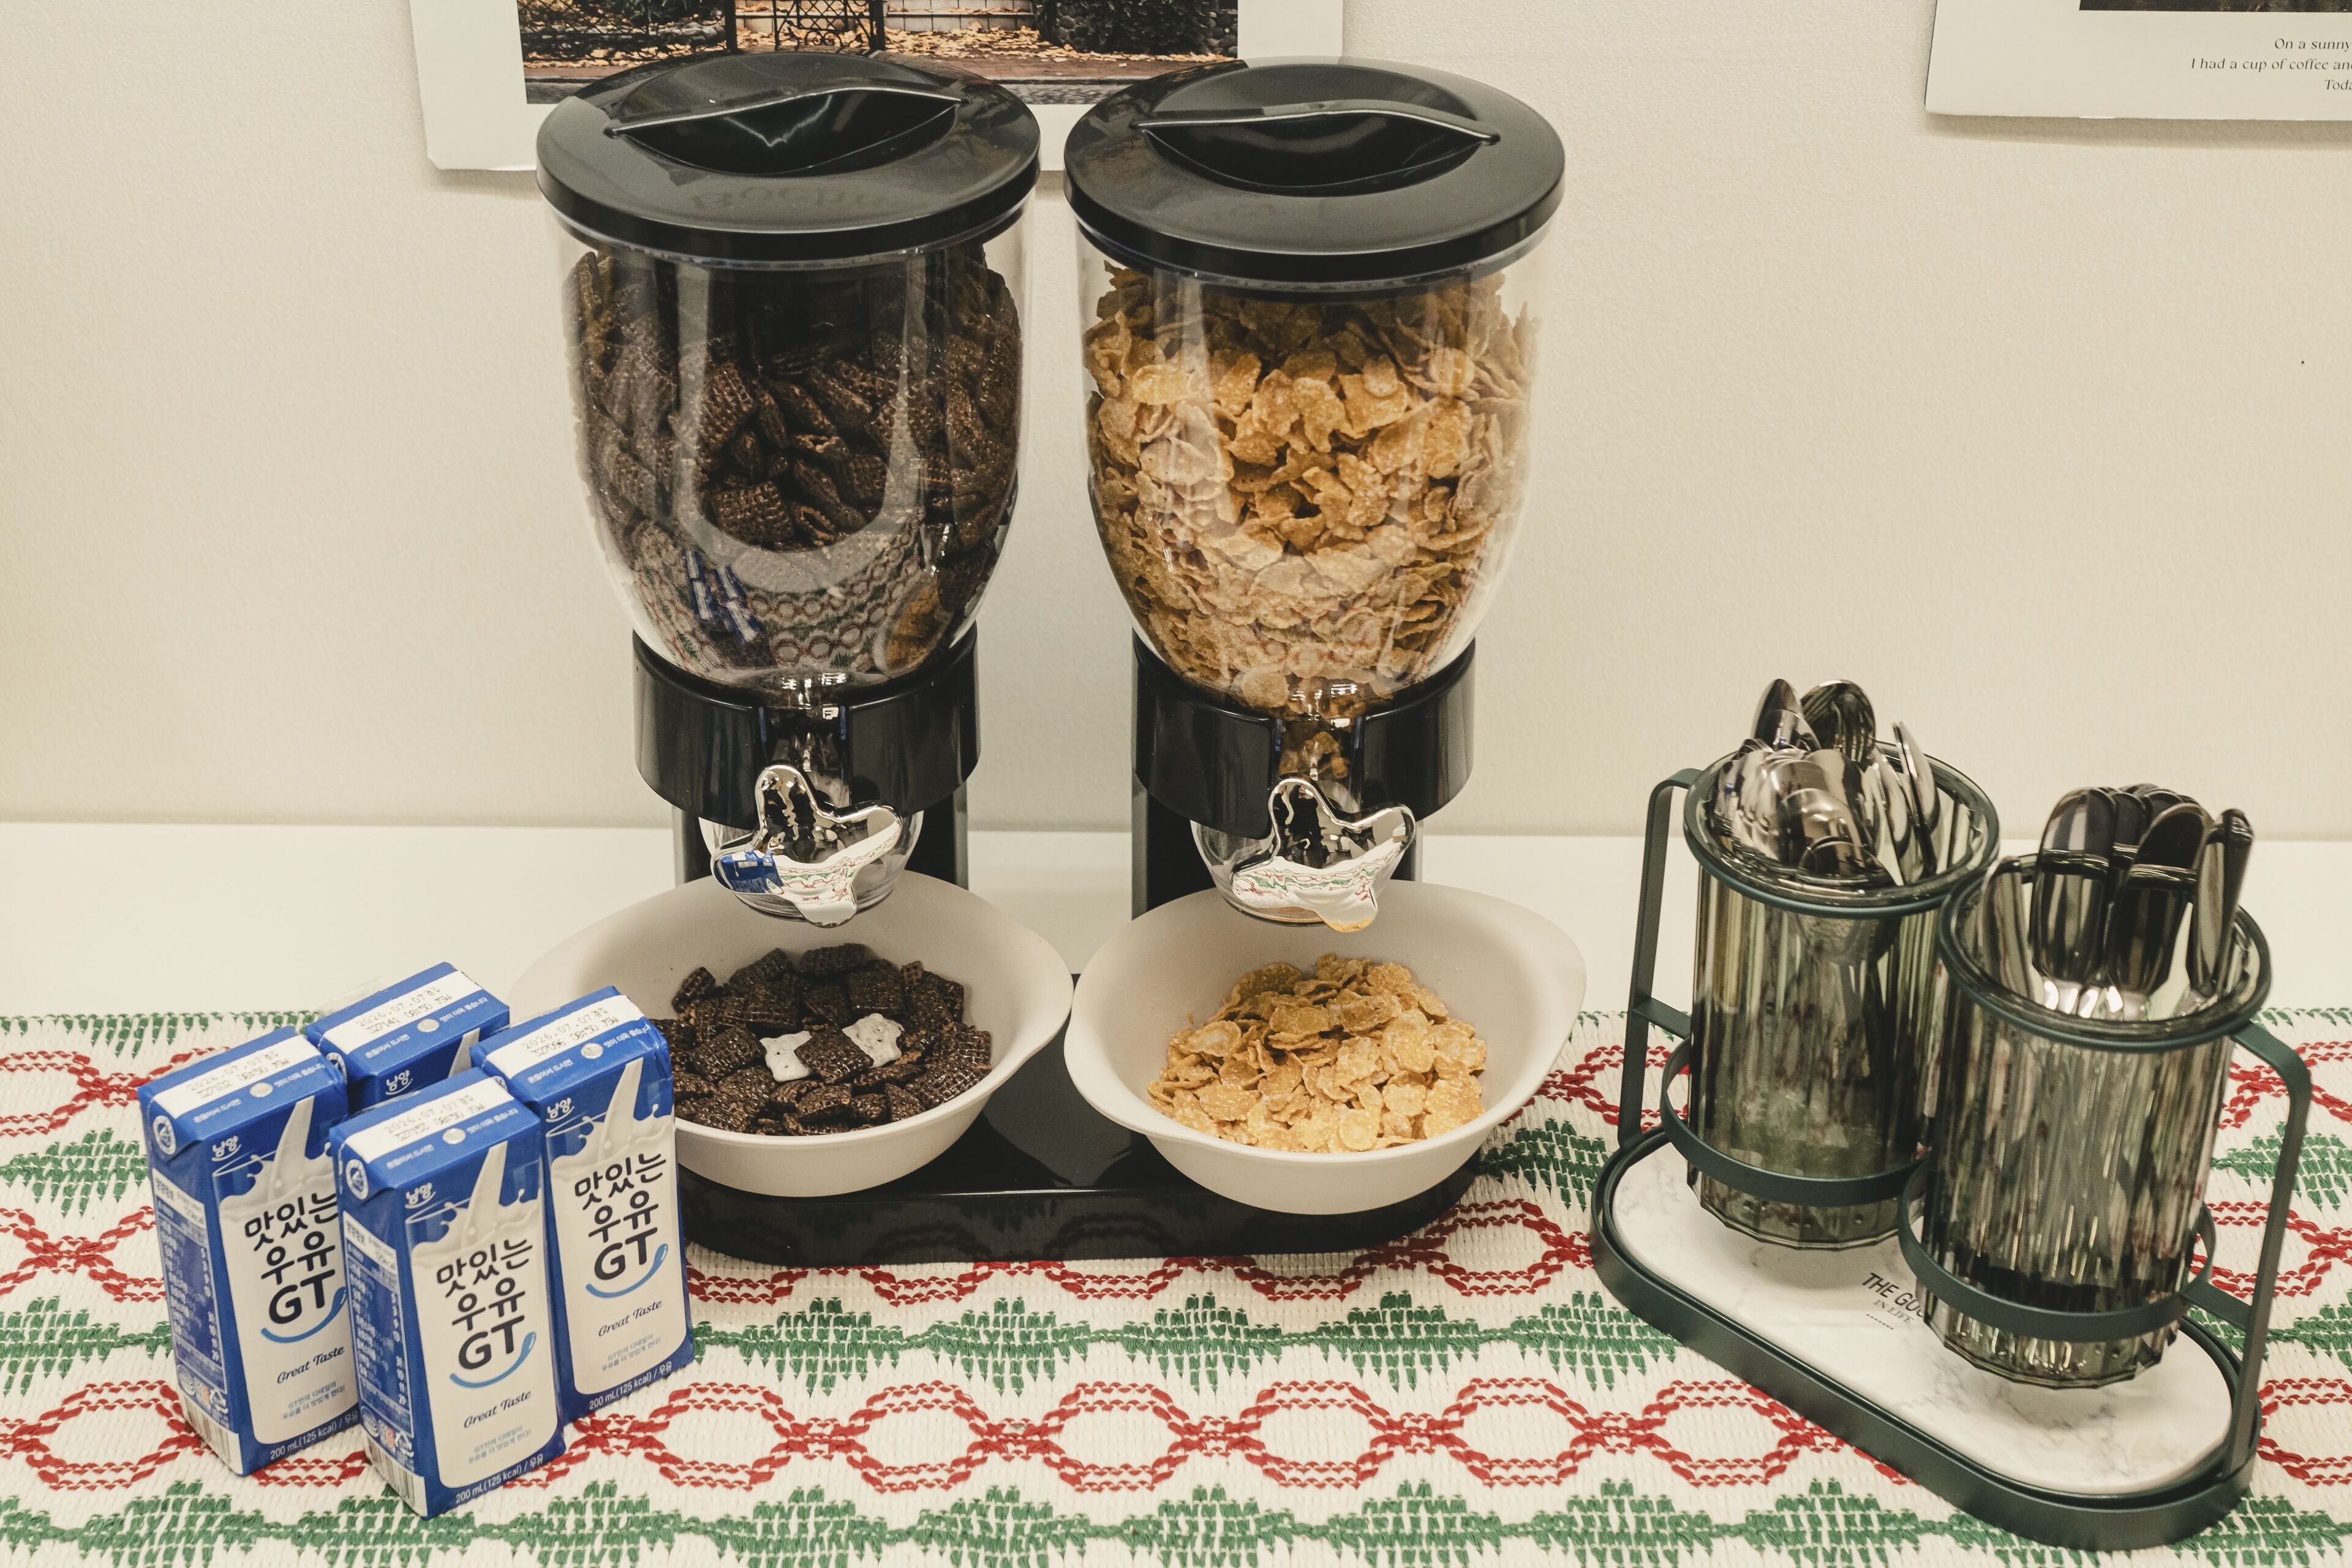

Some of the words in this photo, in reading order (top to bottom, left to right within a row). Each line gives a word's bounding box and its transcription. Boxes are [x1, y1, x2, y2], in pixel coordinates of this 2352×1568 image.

[2191, 58, 2195, 69] I
[2200, 58, 2225, 69] had
[2230, 61, 2237, 69] a
[2242, 61, 2267, 72] cup
[2271, 58, 2288, 69] of
[2289, 58, 2329, 70] coffee
[2333, 61, 2352, 70] an
[2274, 38, 2293, 50] On
[2298, 40, 2305, 50] a
[2311, 40, 2352, 52] sunny
[386, 1069, 410, 1091] 남양
[547, 1097, 572, 1118] 남양
[212, 1136, 239, 1158] 남양
[405, 1182, 432, 1205] 남양
[575, 1153, 666, 1210] 맛있는
[245, 1193, 338, 1251] 맛있는
[588, 1190, 659, 1243] 우유
[261, 1231, 336, 1285] 우유
[437, 1239, 533, 1298] 맛있는
[594, 1227, 658, 1281] GT
[269, 1269, 336, 1324] GT
[452, 1278, 526, 1331] 우유
[1862, 1272, 1900, 1298] THE
[598, 1315, 630, 1336] Great
[633, 1301, 662, 1319] Taste
[1874, 1299, 1889, 1309] IN
[1887, 1307, 1915, 1324] LIFE
[277, 1362, 310, 1384] Great
[313, 1346, 344, 1366] Taste
[458, 1315, 525, 1370] GT
[464, 1406, 497, 1429] Great
[500, 1391, 532, 1410] Taste
[589, 1397, 603, 1410] 200
[605, 1384, 633, 1403] mL(125
[634, 1372, 652, 1386] kcal)
[658, 1360, 673, 1376] 우유
[270, 1446, 286, 1460] 200
[287, 1432, 317, 1453] mL(125
[318, 1421, 337, 1437] kcal)
[344, 1410, 358, 1425] 우유
[456, 1490, 471, 1504] 200
[472, 1475, 502, 1496] mL(125
[503, 1464, 522, 1480] kcal)
[529, 1453, 544, 1468] 우유
